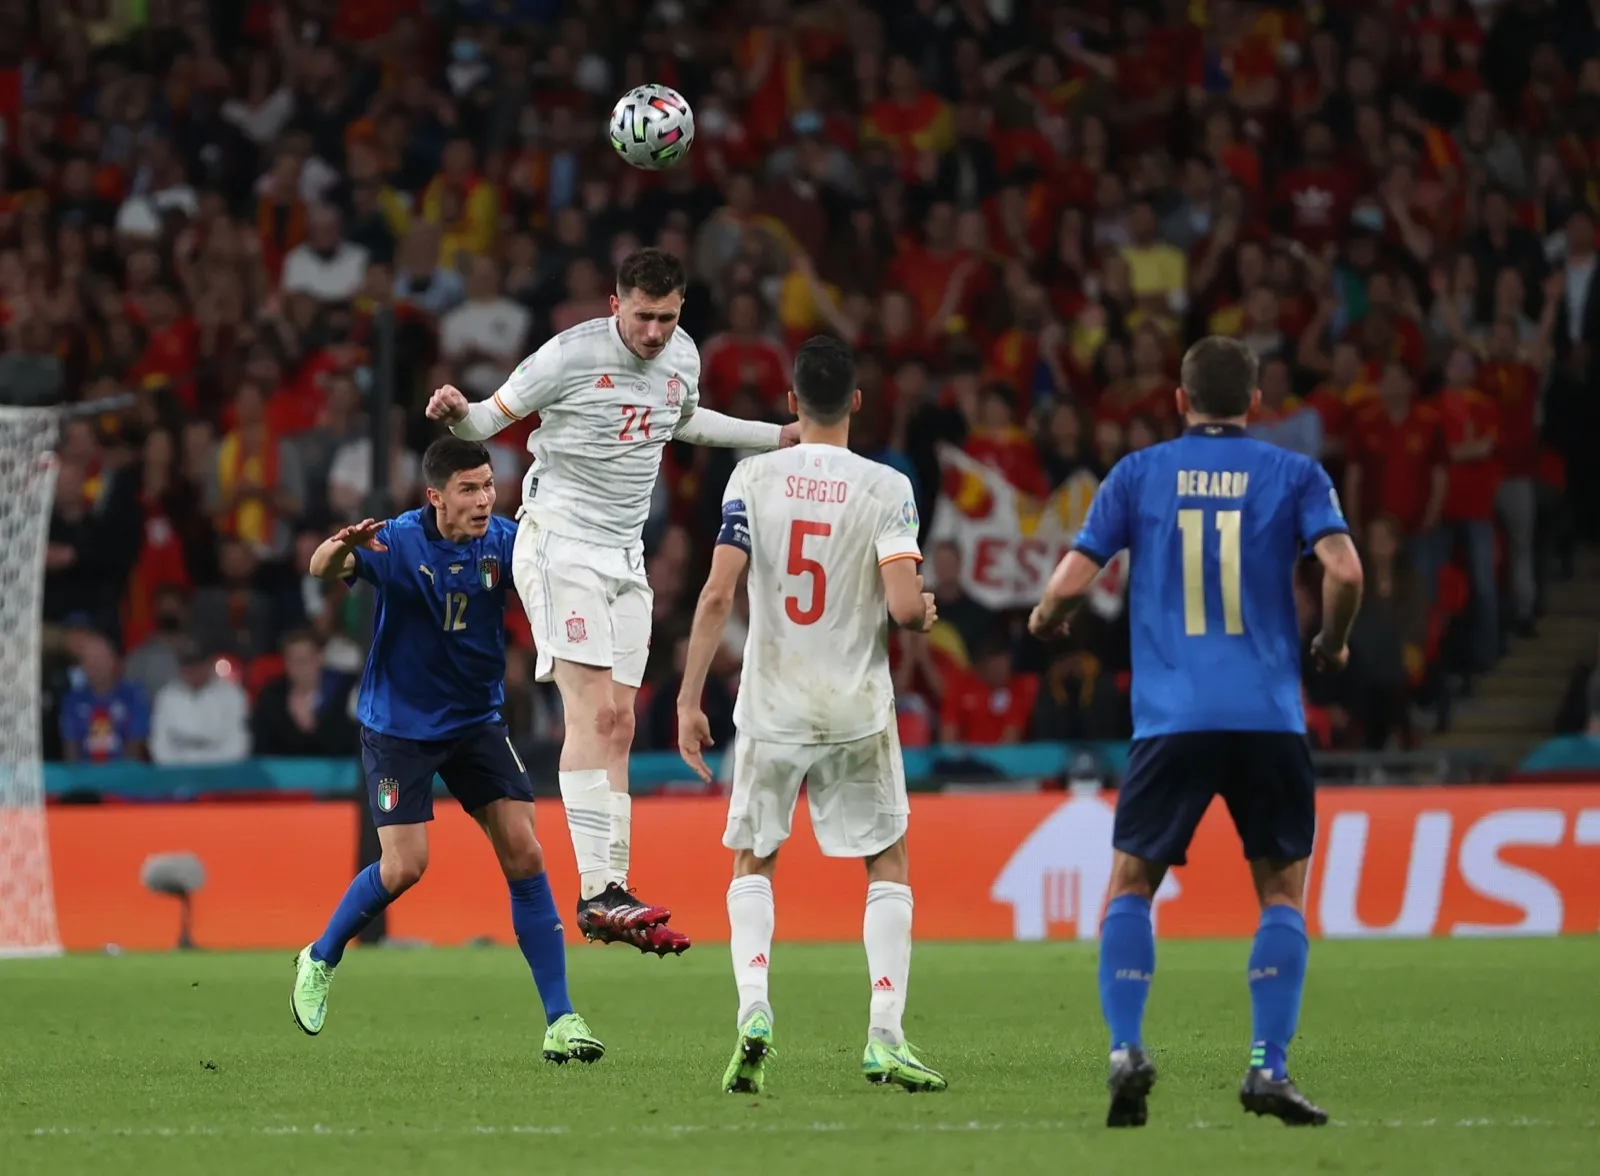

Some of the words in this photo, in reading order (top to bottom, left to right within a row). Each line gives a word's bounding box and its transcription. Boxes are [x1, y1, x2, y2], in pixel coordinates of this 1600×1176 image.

[618, 404, 652, 441] 24
[785, 475, 847, 503] SERGIO
[784, 519, 831, 626] 5
[1177, 509, 1244, 636] 11
[443, 592, 468, 632] 12
[1303, 807, 1600, 939] US
